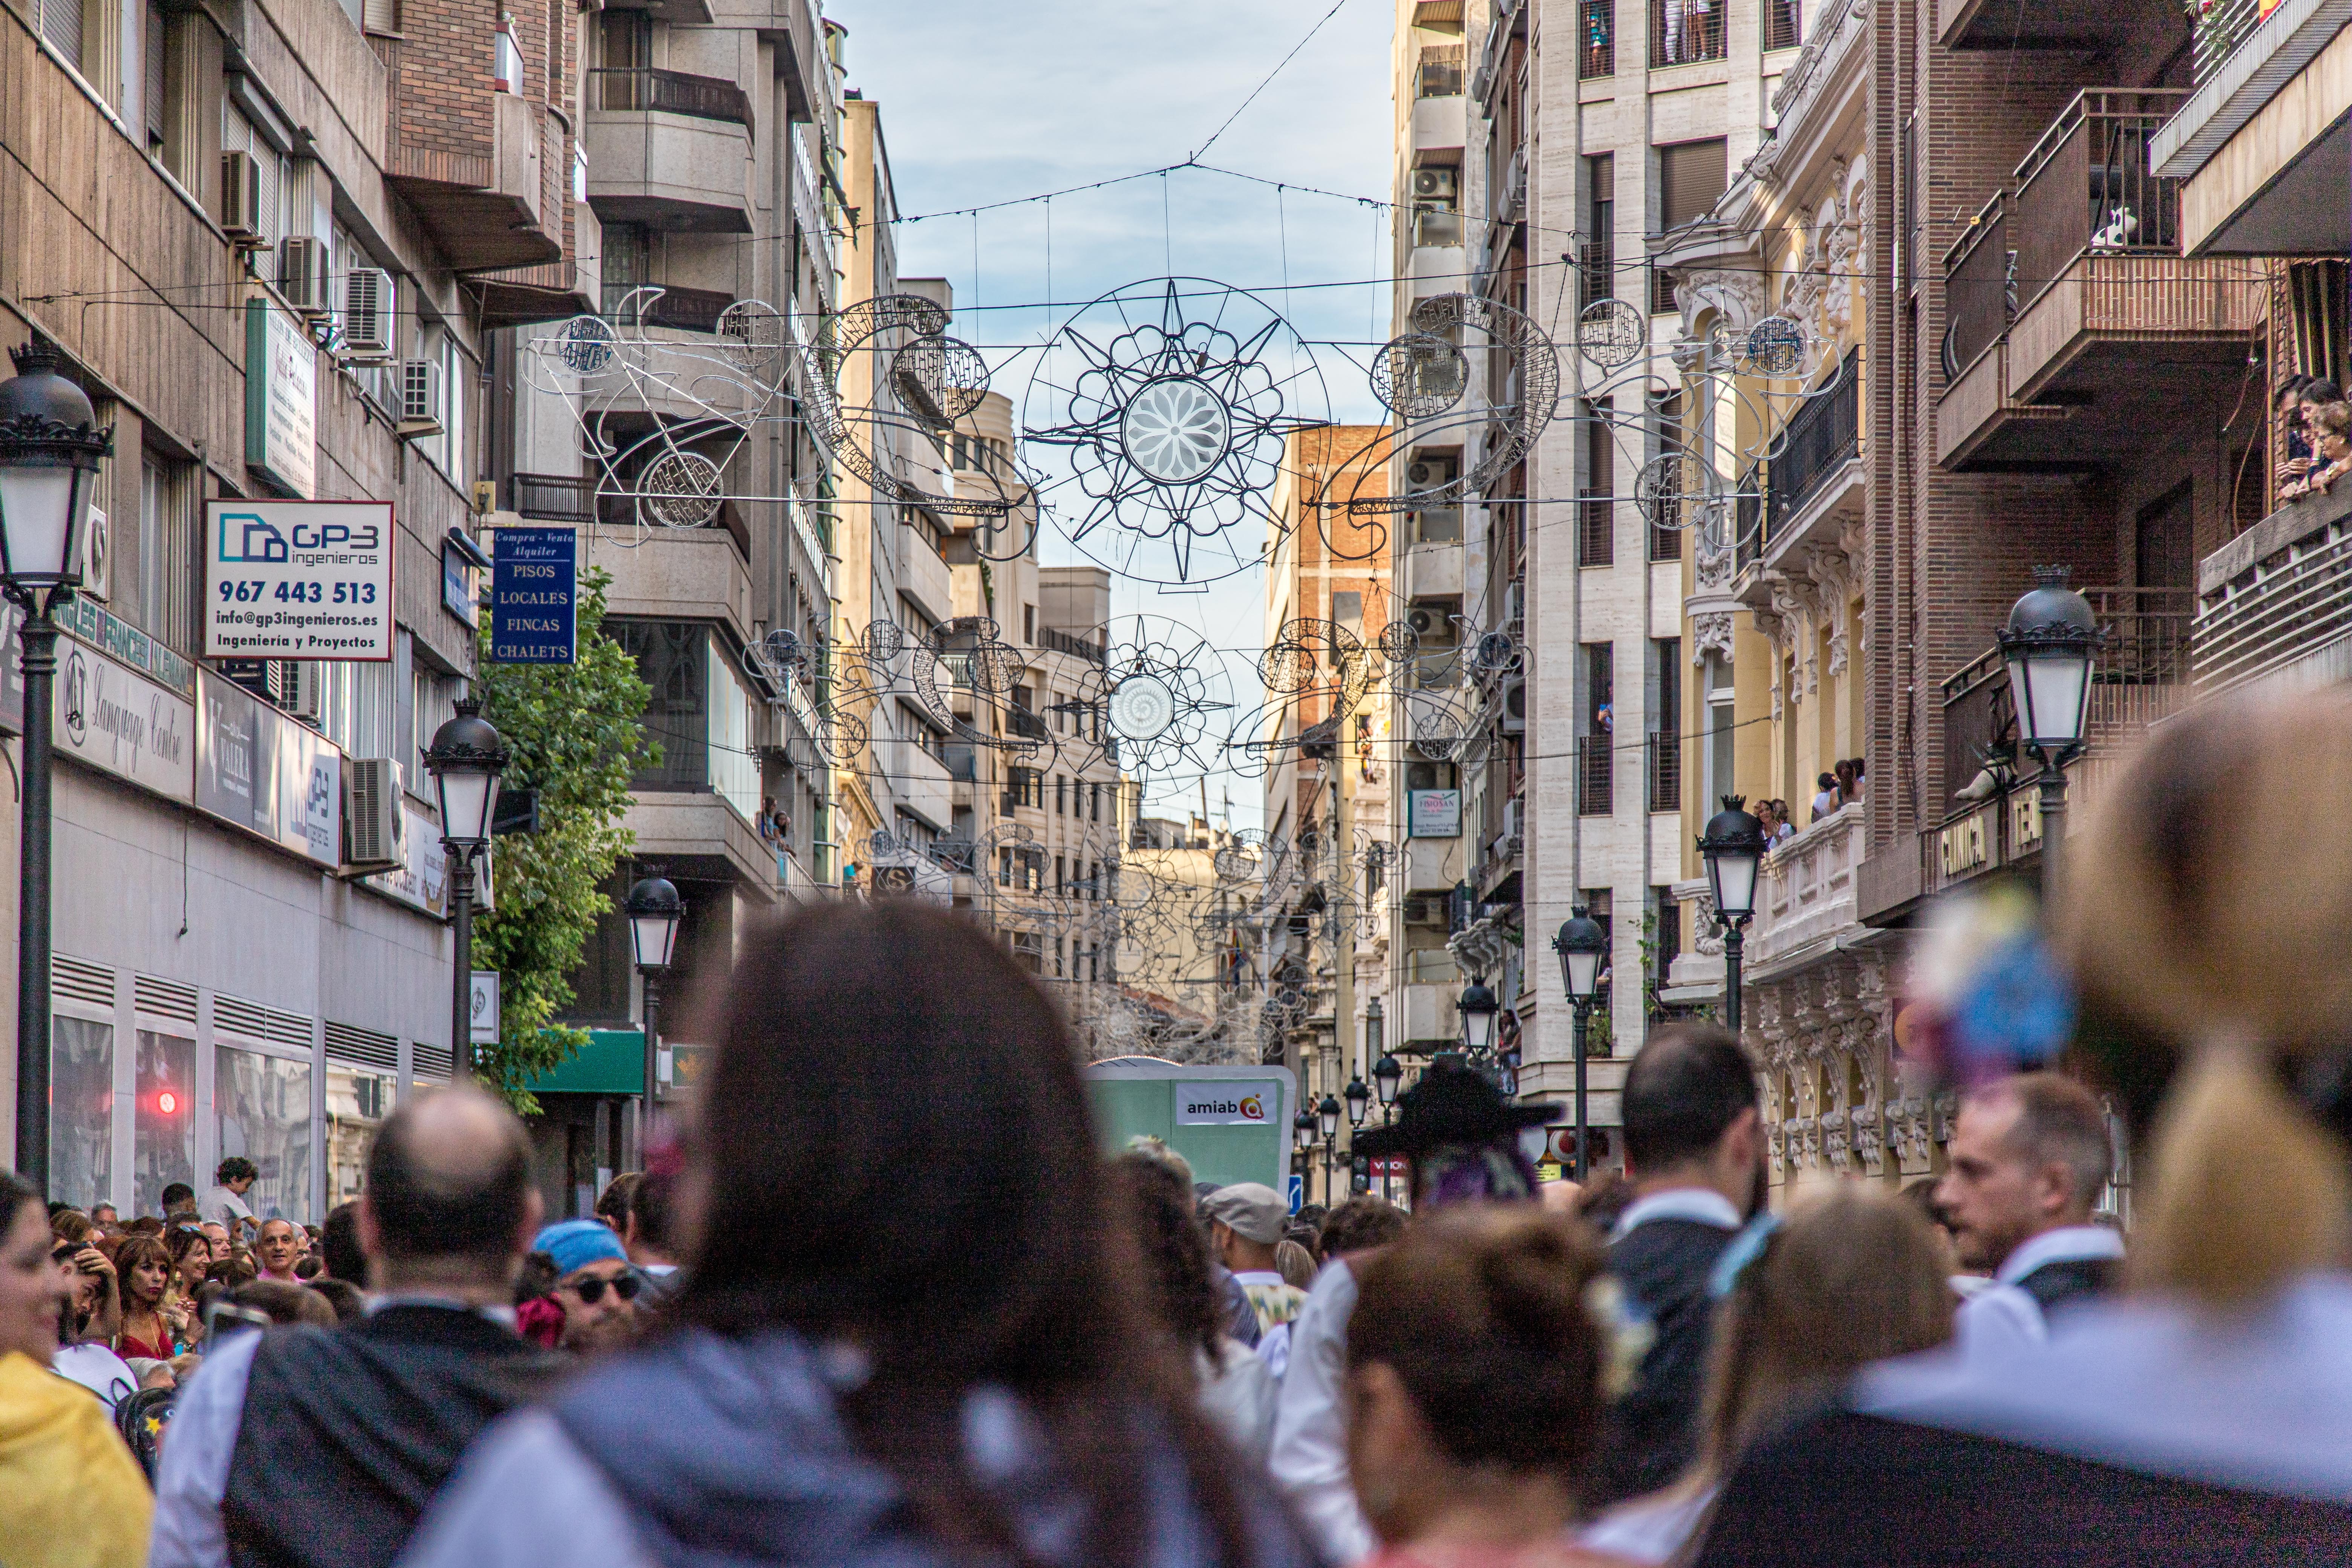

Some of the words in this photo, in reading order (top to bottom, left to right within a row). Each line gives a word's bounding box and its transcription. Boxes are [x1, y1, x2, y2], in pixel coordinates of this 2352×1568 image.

[292, 524, 379, 549] GP3
[496, 532, 535, 544] Compra
[547, 533, 573, 542] Venta
[292, 551, 378, 566] ingenieros
[513, 546, 556, 558] Alquiler
[513, 565, 555, 578] PISOS
[219, 580, 266, 602] 967
[274, 581, 322, 603] 443
[332, 582, 376, 603] 513
[501, 591, 568, 604] LOCALES
[216, 610, 378, 628] info@gp3ingenieros.es
[508, 619, 560, 631] FINCAS
[217, 633, 289, 649] Ingeniería
[296, 637, 303, 650] y
[308, 635, 375, 651] Proyectos
[497, 645, 568, 658] CHALETS
[93, 663, 144, 773] Language
[150, 693, 181, 766] Centre
[1187, 1100, 1238, 1114] amiab
